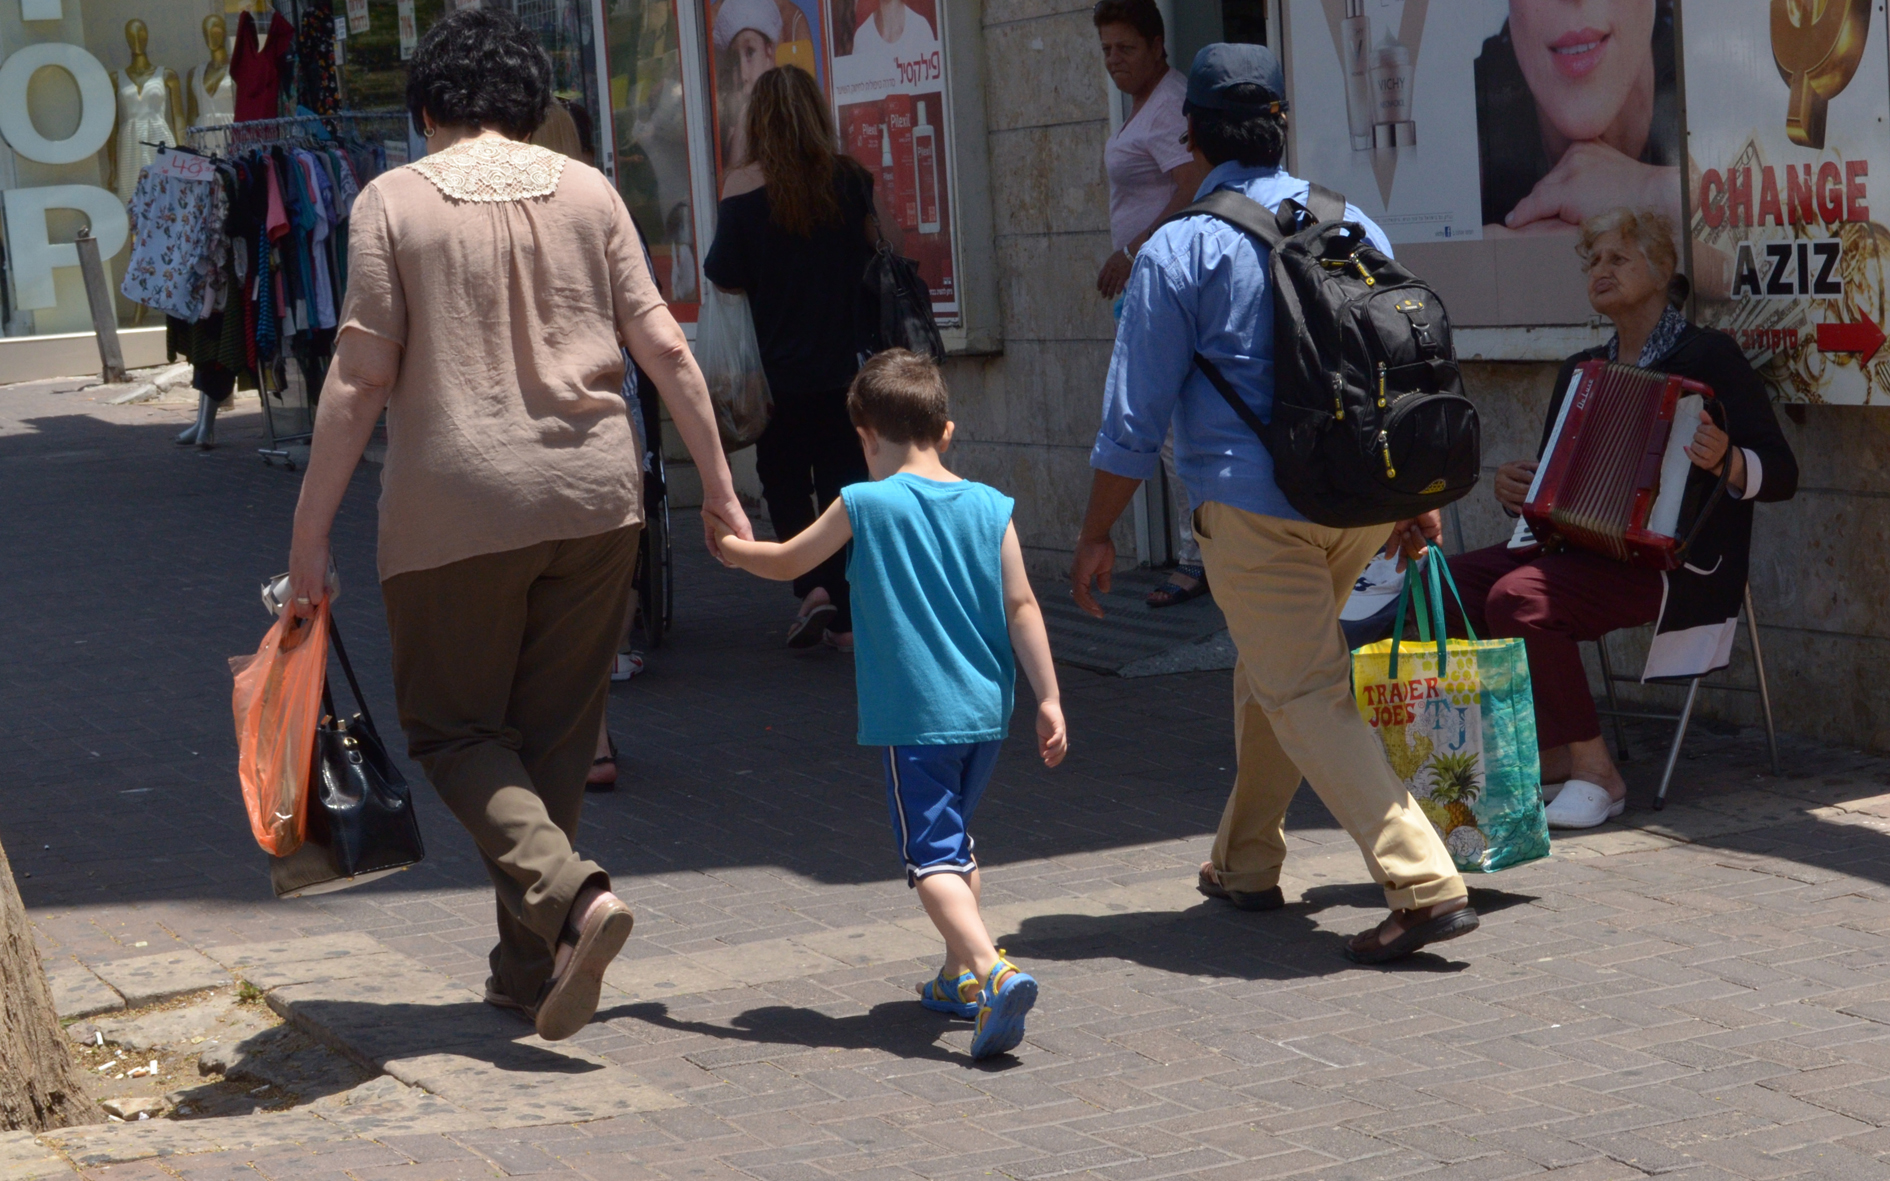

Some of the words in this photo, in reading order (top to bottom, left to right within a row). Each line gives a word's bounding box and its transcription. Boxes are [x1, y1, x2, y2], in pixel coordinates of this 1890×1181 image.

[1378, 77, 1406, 91] VICHY
[890, 114, 911, 128] Pilexil
[1700, 159, 1870, 229] CHANGE
[1731, 239, 1843, 298] AZIZ
